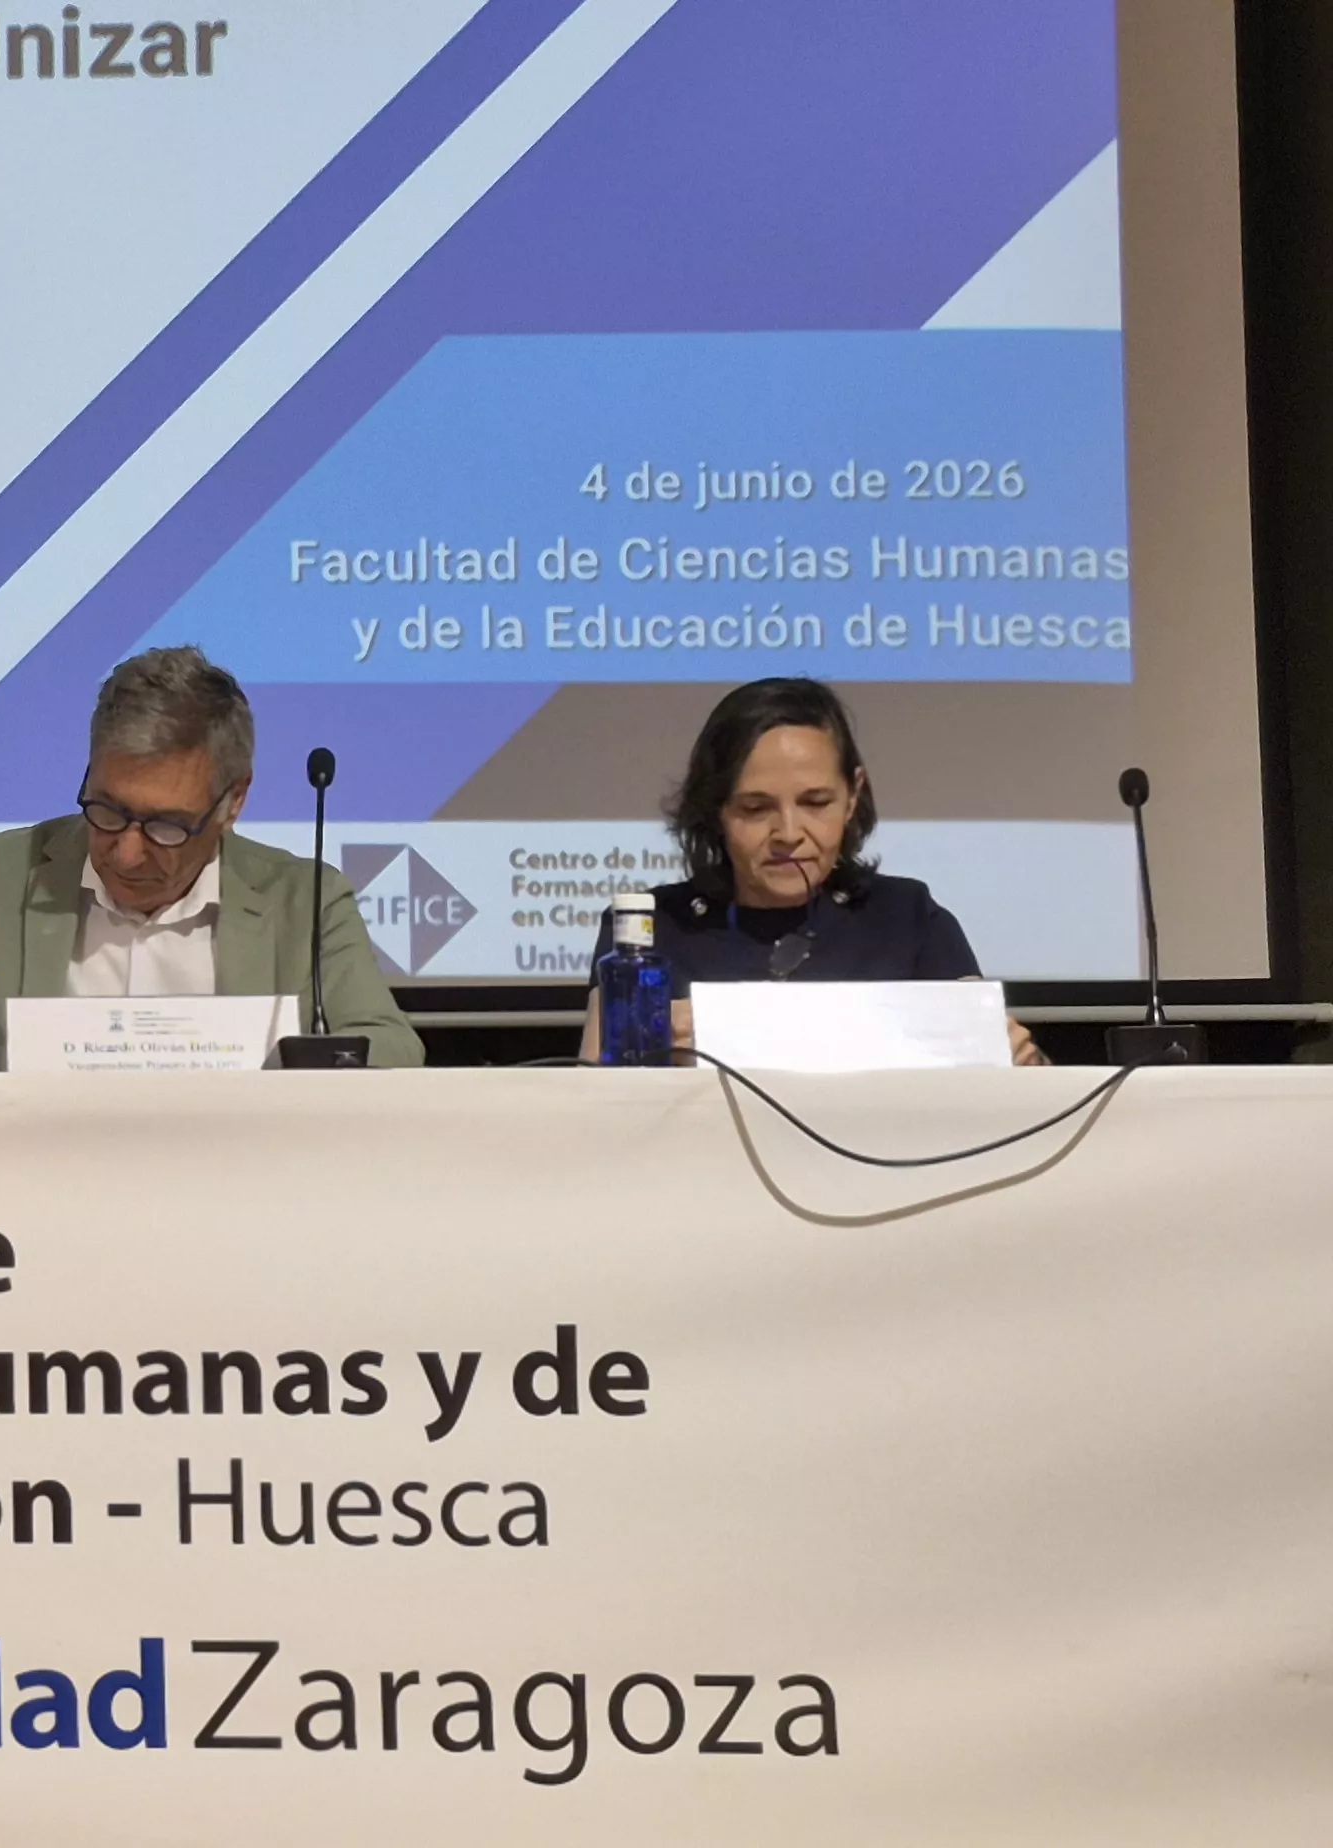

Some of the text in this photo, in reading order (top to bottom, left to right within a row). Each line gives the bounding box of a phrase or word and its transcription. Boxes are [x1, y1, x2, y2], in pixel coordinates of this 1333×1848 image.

[579, 459, 1025, 510] 4 de junio de 2026
[289, 534, 1129, 582] Facultad de Ciencias Humanas
[351, 602, 1130, 662] y de la Educación de Huesca
[509, 847, 598, 871] Centro
[603, 846, 637, 871] de
[511, 874, 649, 897] Formación
[511, 908, 545, 928] en
[415, 1351, 483, 1441] y
[511, 1324, 651, 1418] de
[177, 1458, 551, 1548] Huesca
[190, 1640, 841, 1787] Zaragoza
